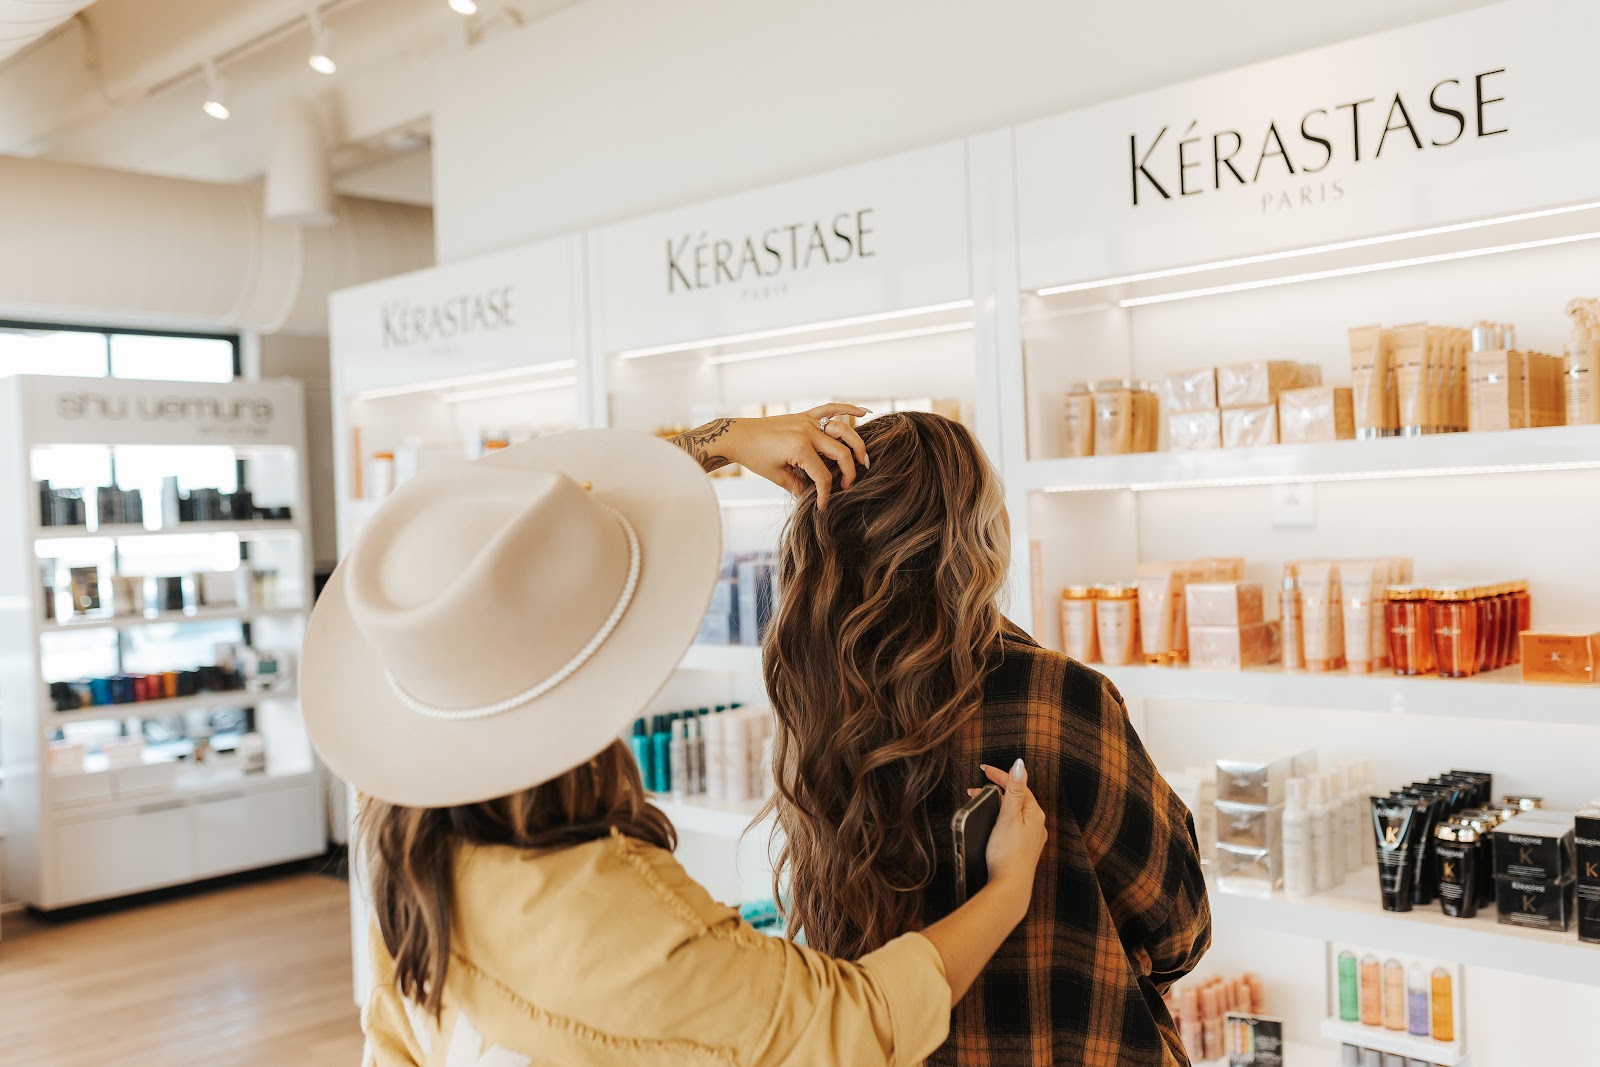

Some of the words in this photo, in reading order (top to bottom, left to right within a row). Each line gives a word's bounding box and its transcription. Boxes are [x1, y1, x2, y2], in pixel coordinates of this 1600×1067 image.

[1129, 68, 1508, 207] KÉRASTASE
[1261, 179, 1346, 213] PARIS
[666, 207, 876, 294] KÉRASTASE
[1520, 847, 1533, 865] K
[1585, 861, 1599, 878] K
[1522, 895, 1537, 912] K
